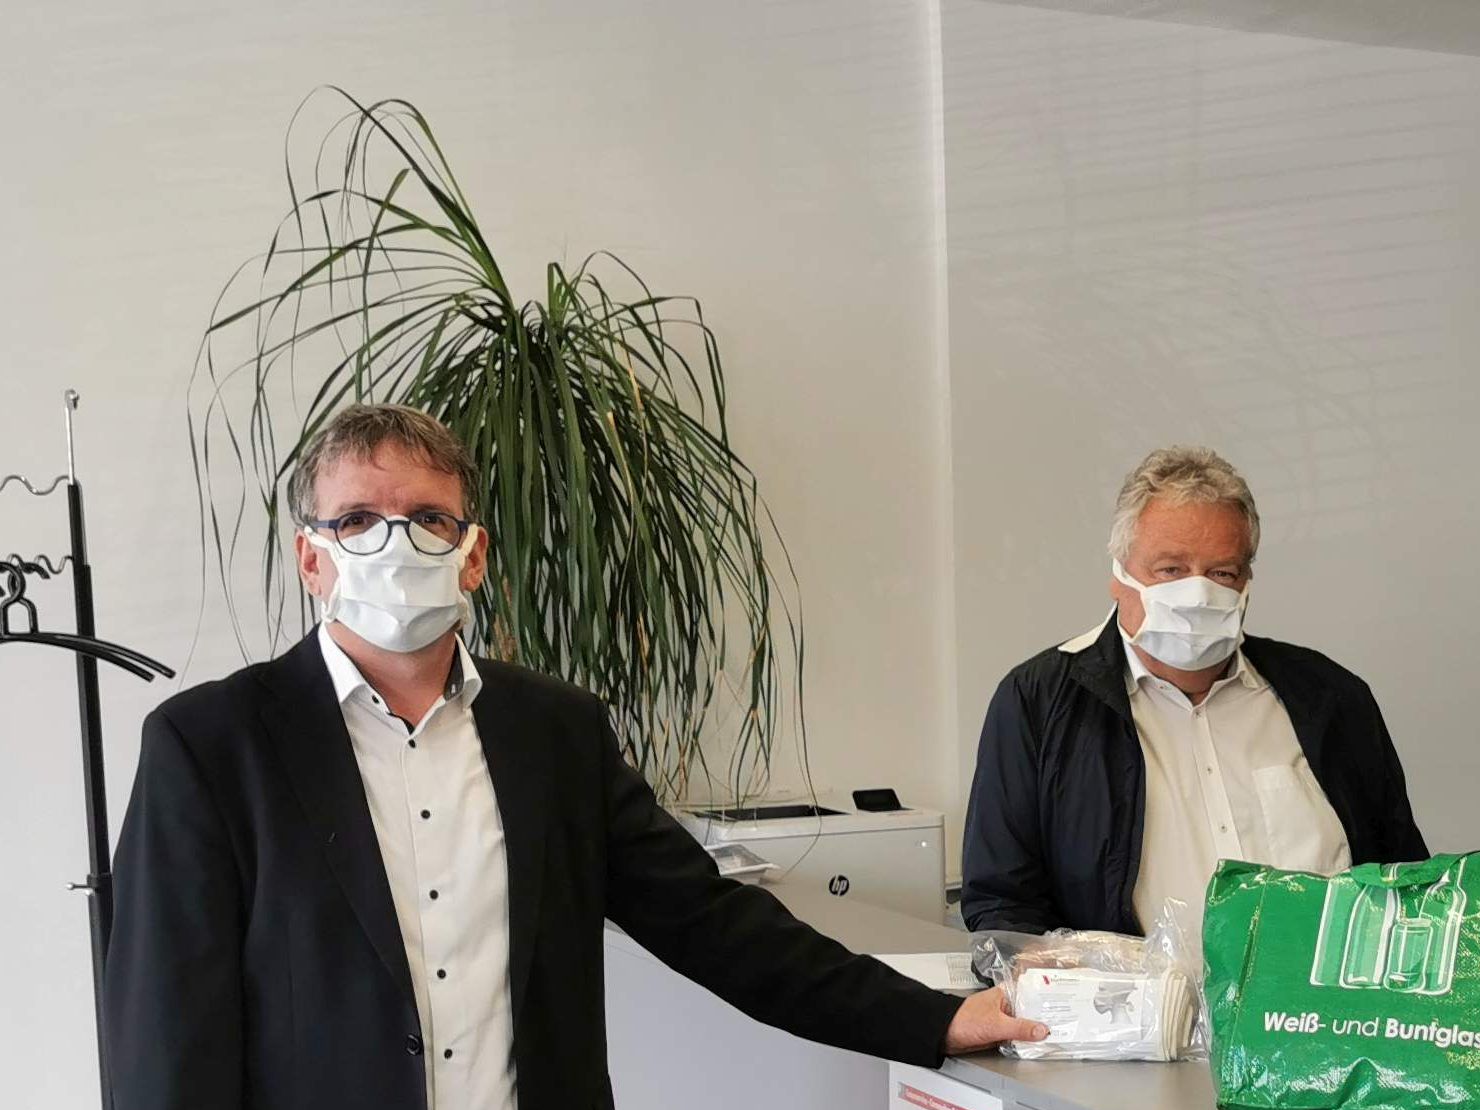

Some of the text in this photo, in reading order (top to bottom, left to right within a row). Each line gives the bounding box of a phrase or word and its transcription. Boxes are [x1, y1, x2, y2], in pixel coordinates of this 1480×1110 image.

[831, 874, 849, 896] hp
[1264, 1011, 1327, 1034] Weiß-
[1332, 1016, 1379, 1037] und
